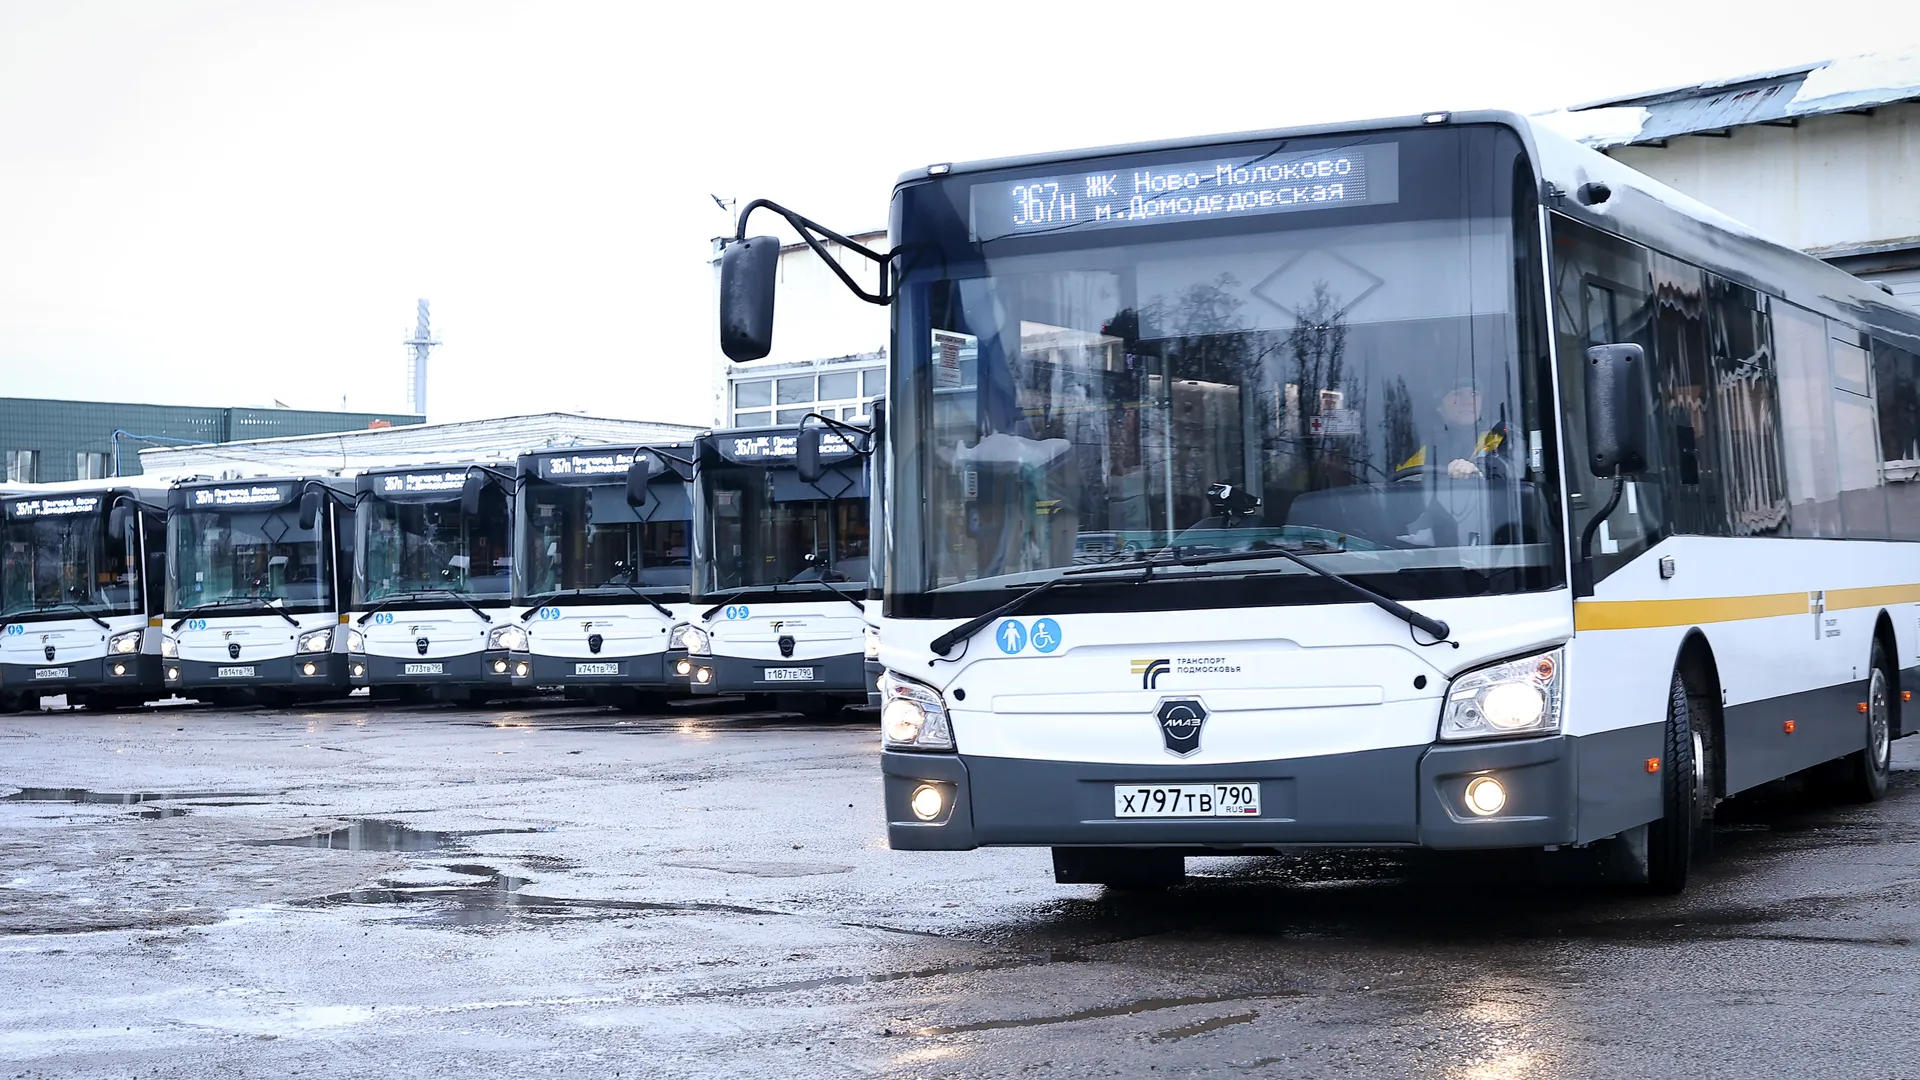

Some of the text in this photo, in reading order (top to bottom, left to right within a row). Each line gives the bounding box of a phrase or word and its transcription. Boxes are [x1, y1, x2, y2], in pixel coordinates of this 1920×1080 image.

[1085, 174, 1118, 198] ЖК
[1133, 158, 1351, 194] Ново-Молоково
[1094, 183, 1345, 221] м.Домодедовская
[1177, 666, 1241, 674] ПОДМОСКОВЬЯ
[1163, 718, 1202, 727] ЛИАЗ
[1217, 786, 1253, 805] 790
[1225, 805, 1244, 813] RUS
